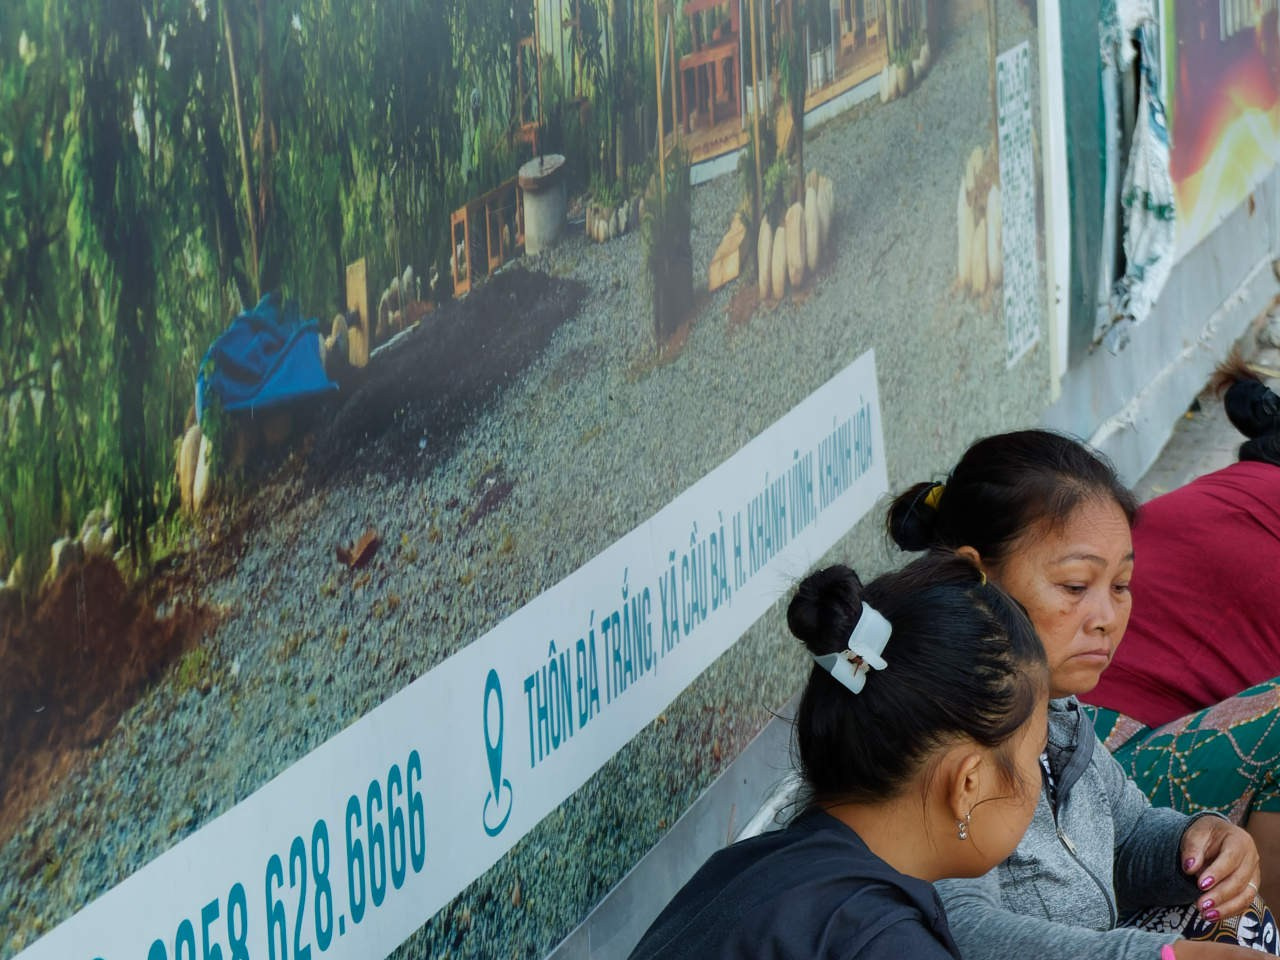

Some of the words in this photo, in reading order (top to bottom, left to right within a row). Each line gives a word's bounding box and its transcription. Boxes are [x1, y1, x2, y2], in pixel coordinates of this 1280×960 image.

[523, 639, 574, 768] THÔN
[575, 609, 600, 730] ĐÁ
[601, 567, 657, 704] TRẮNG,
[659, 549, 680, 658] XÃ
[681, 521, 708, 636] CẦU
[710, 510, 732, 608] BÀ,
[732, 511, 746, 591] H.
[748, 471, 788, 577] KHÁNH
[787, 448, 817, 539] VĨNH,
[818, 415, 853, 512] KHÁNH
[853, 393, 873, 481] HÒA
